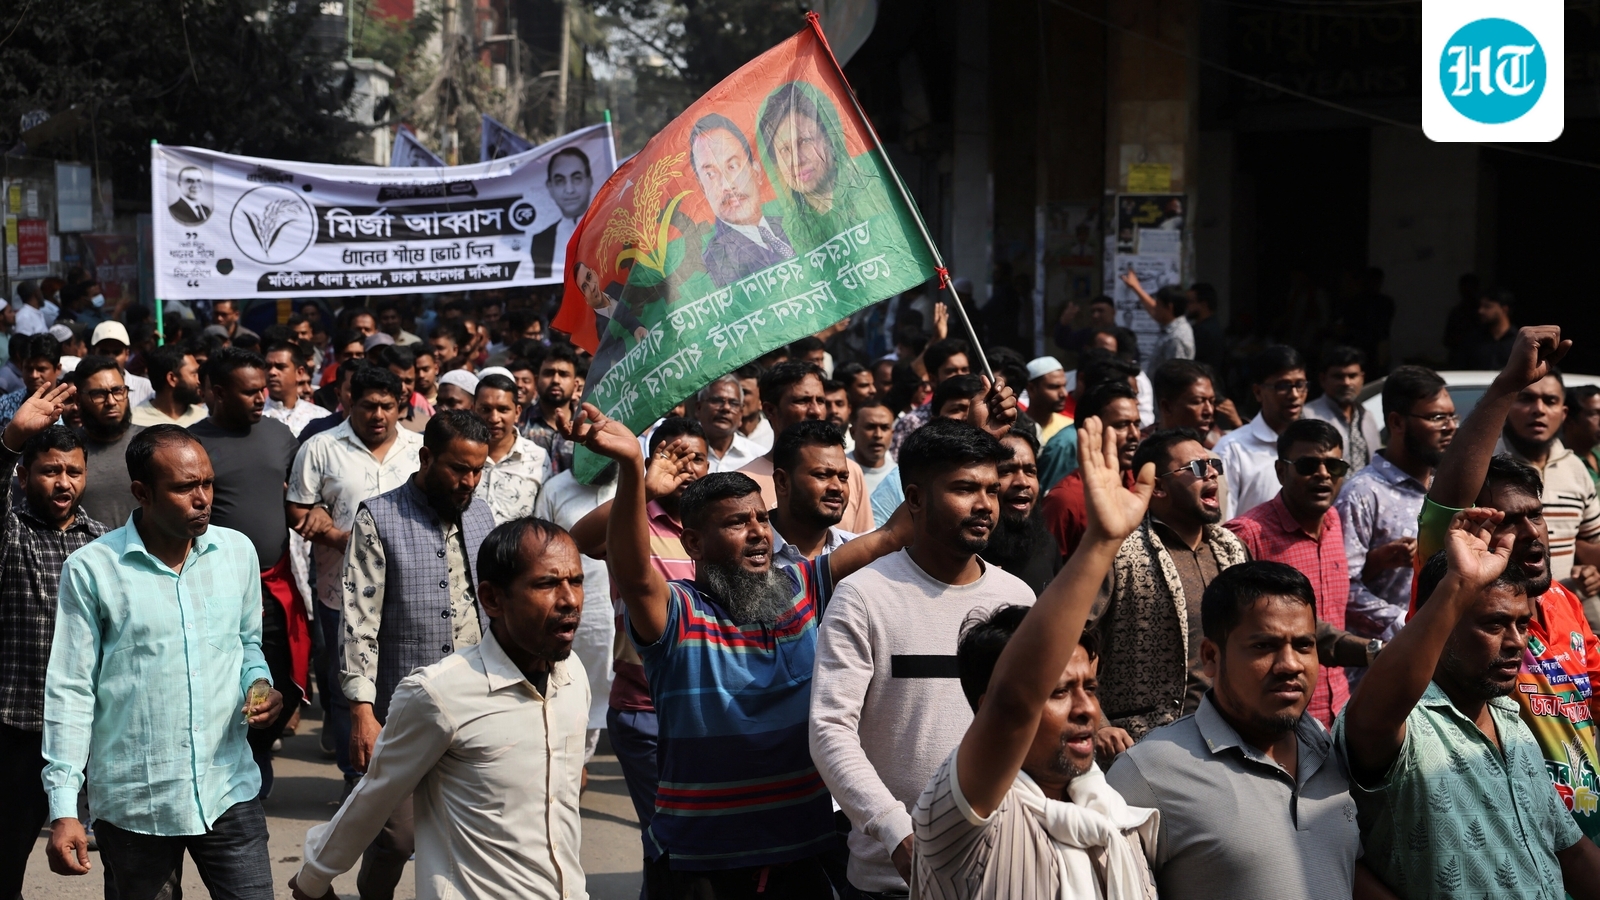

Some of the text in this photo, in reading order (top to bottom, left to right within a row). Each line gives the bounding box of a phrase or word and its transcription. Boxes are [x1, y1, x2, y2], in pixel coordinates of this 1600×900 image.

[324, 207, 534, 238] মির্জা আব্বাস কে
[342, 241, 494, 267] ধানের শীষে ভোট দিন
[268, 272, 315, 287] মতিঝিল
[318, 272, 344, 287] থানা
[390, 269, 417, 284] ঢাকা
[420, 267, 465, 283] মহানগর
[1575, 786, 1599, 818] দিন
